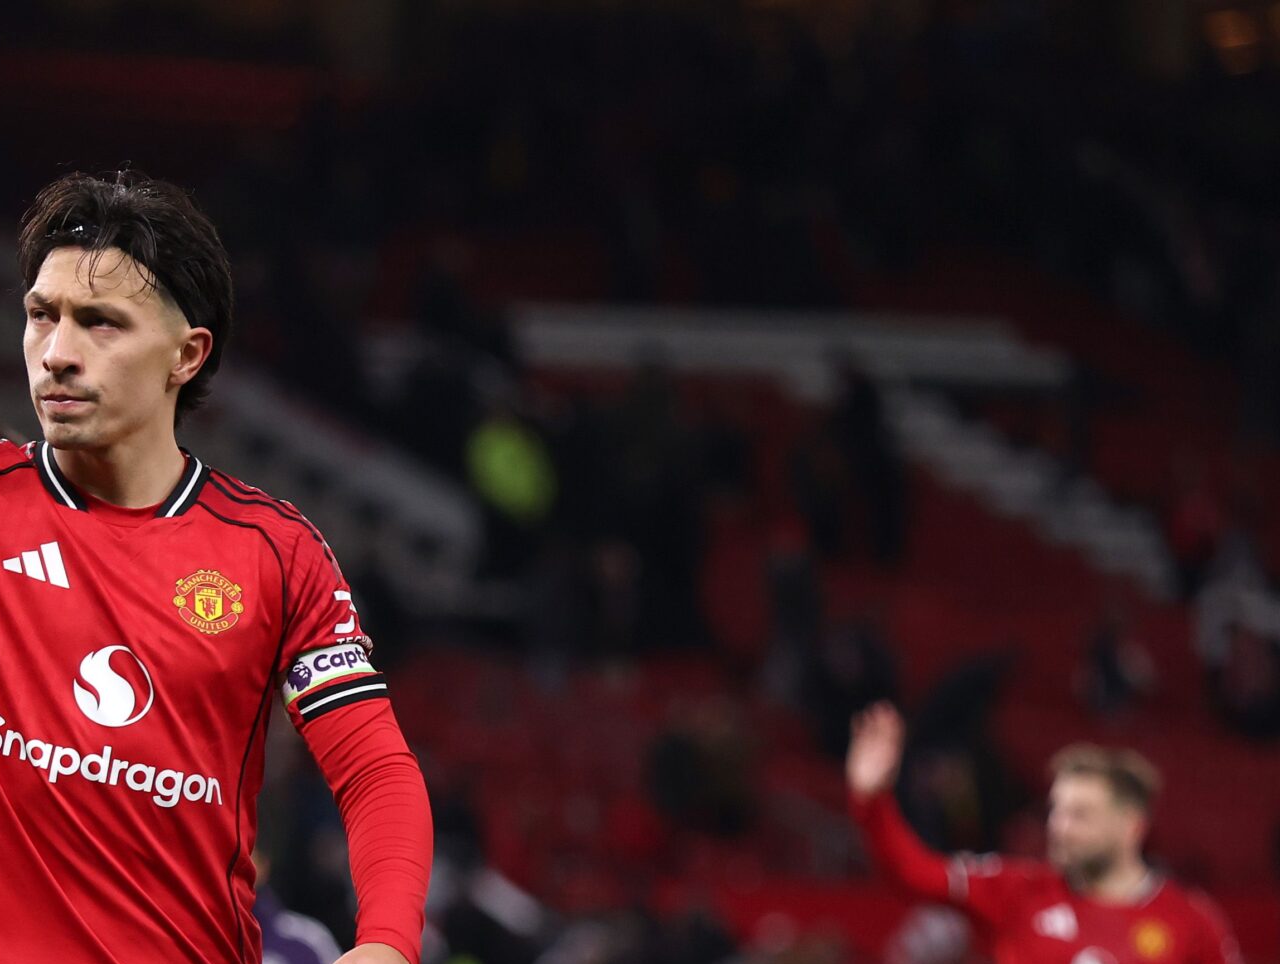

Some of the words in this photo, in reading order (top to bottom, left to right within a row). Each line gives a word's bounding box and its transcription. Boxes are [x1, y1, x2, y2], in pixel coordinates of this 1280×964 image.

[181, 574, 237, 598] MANCHESTER
[190, 616, 229, 630] UNITED
[313, 647, 369, 672] Capt
